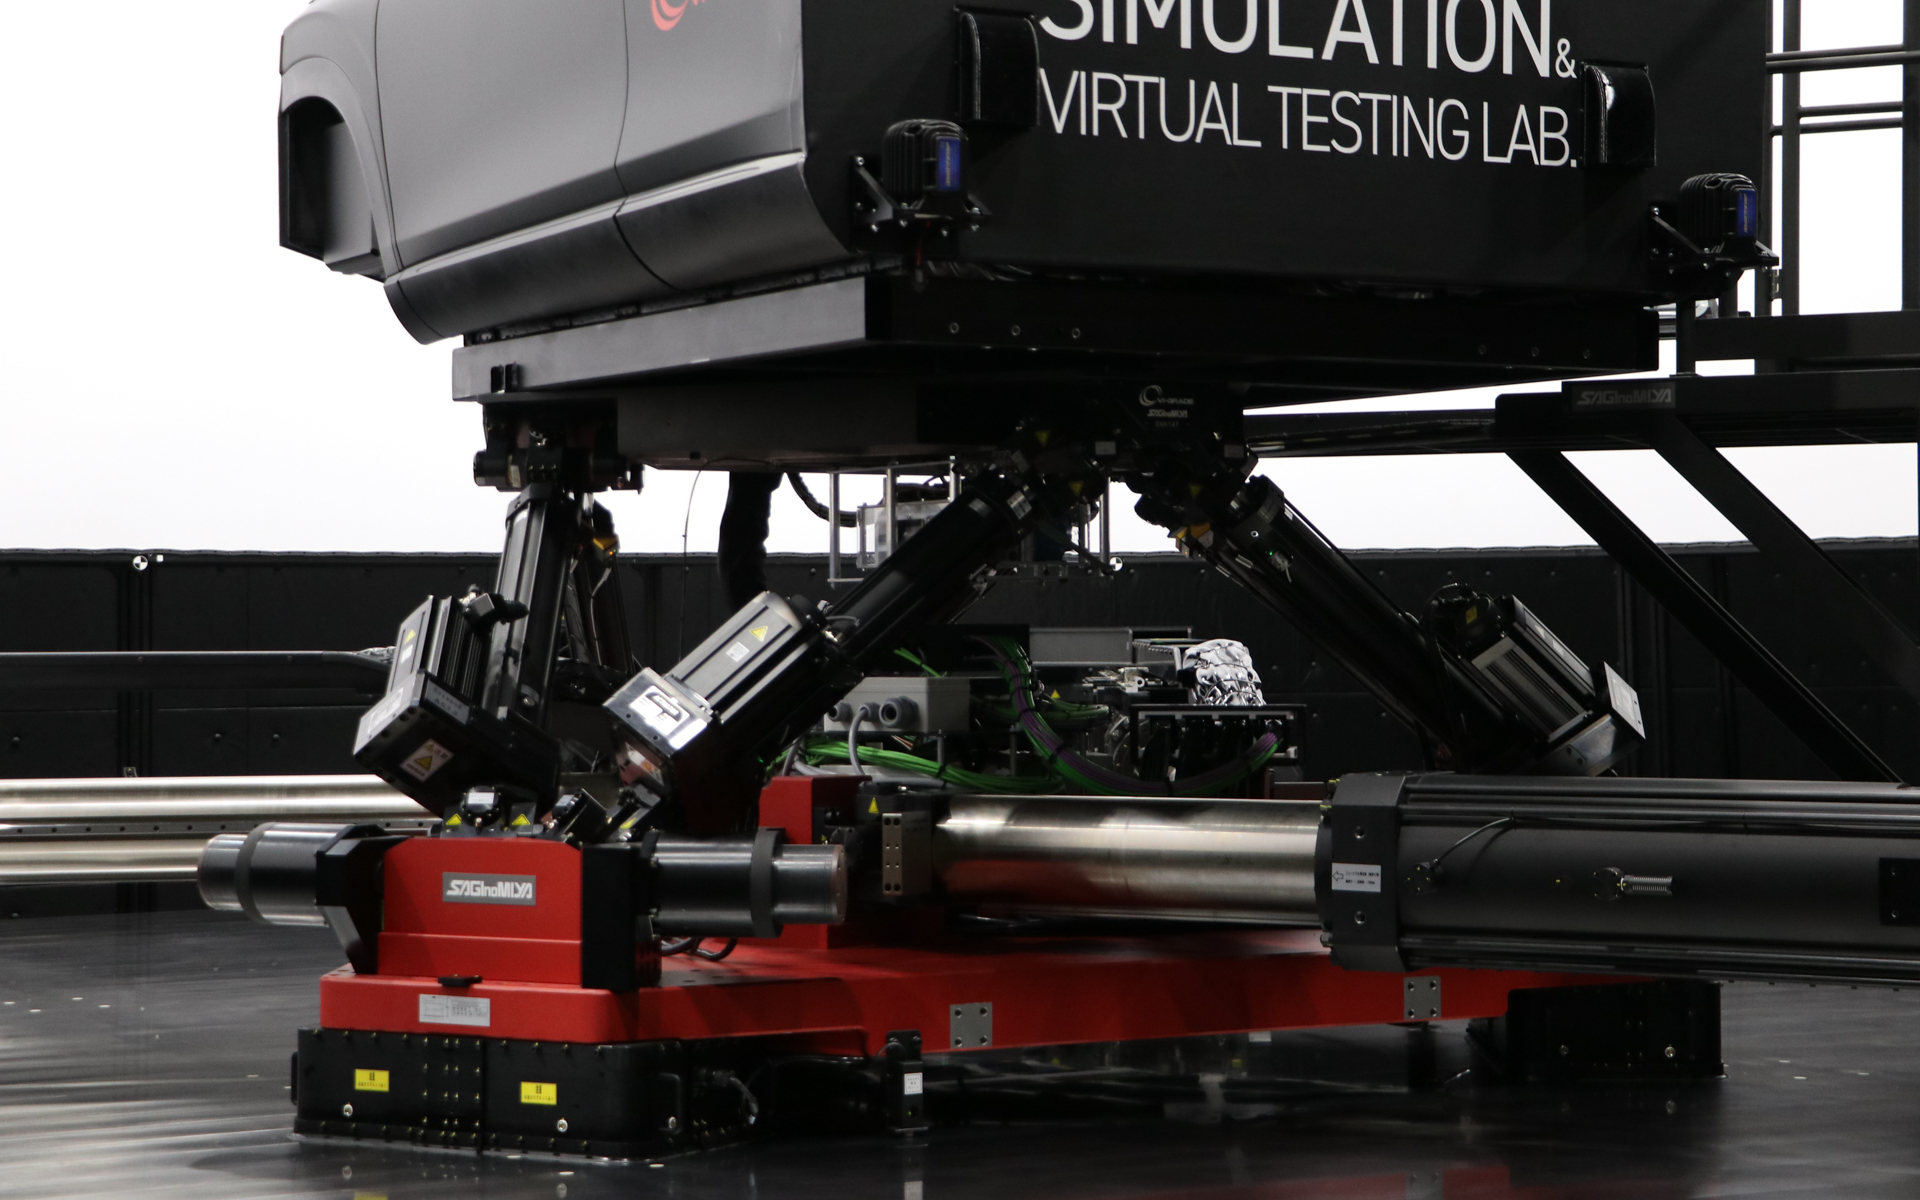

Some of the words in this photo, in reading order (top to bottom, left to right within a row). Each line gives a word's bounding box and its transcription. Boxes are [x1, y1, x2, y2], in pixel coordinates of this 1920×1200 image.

[1039, 67, 1262, 148] VIRTUAL
[1267, 85, 1470, 161] TESTING
[1483, 101, 1577, 168] LAB.
